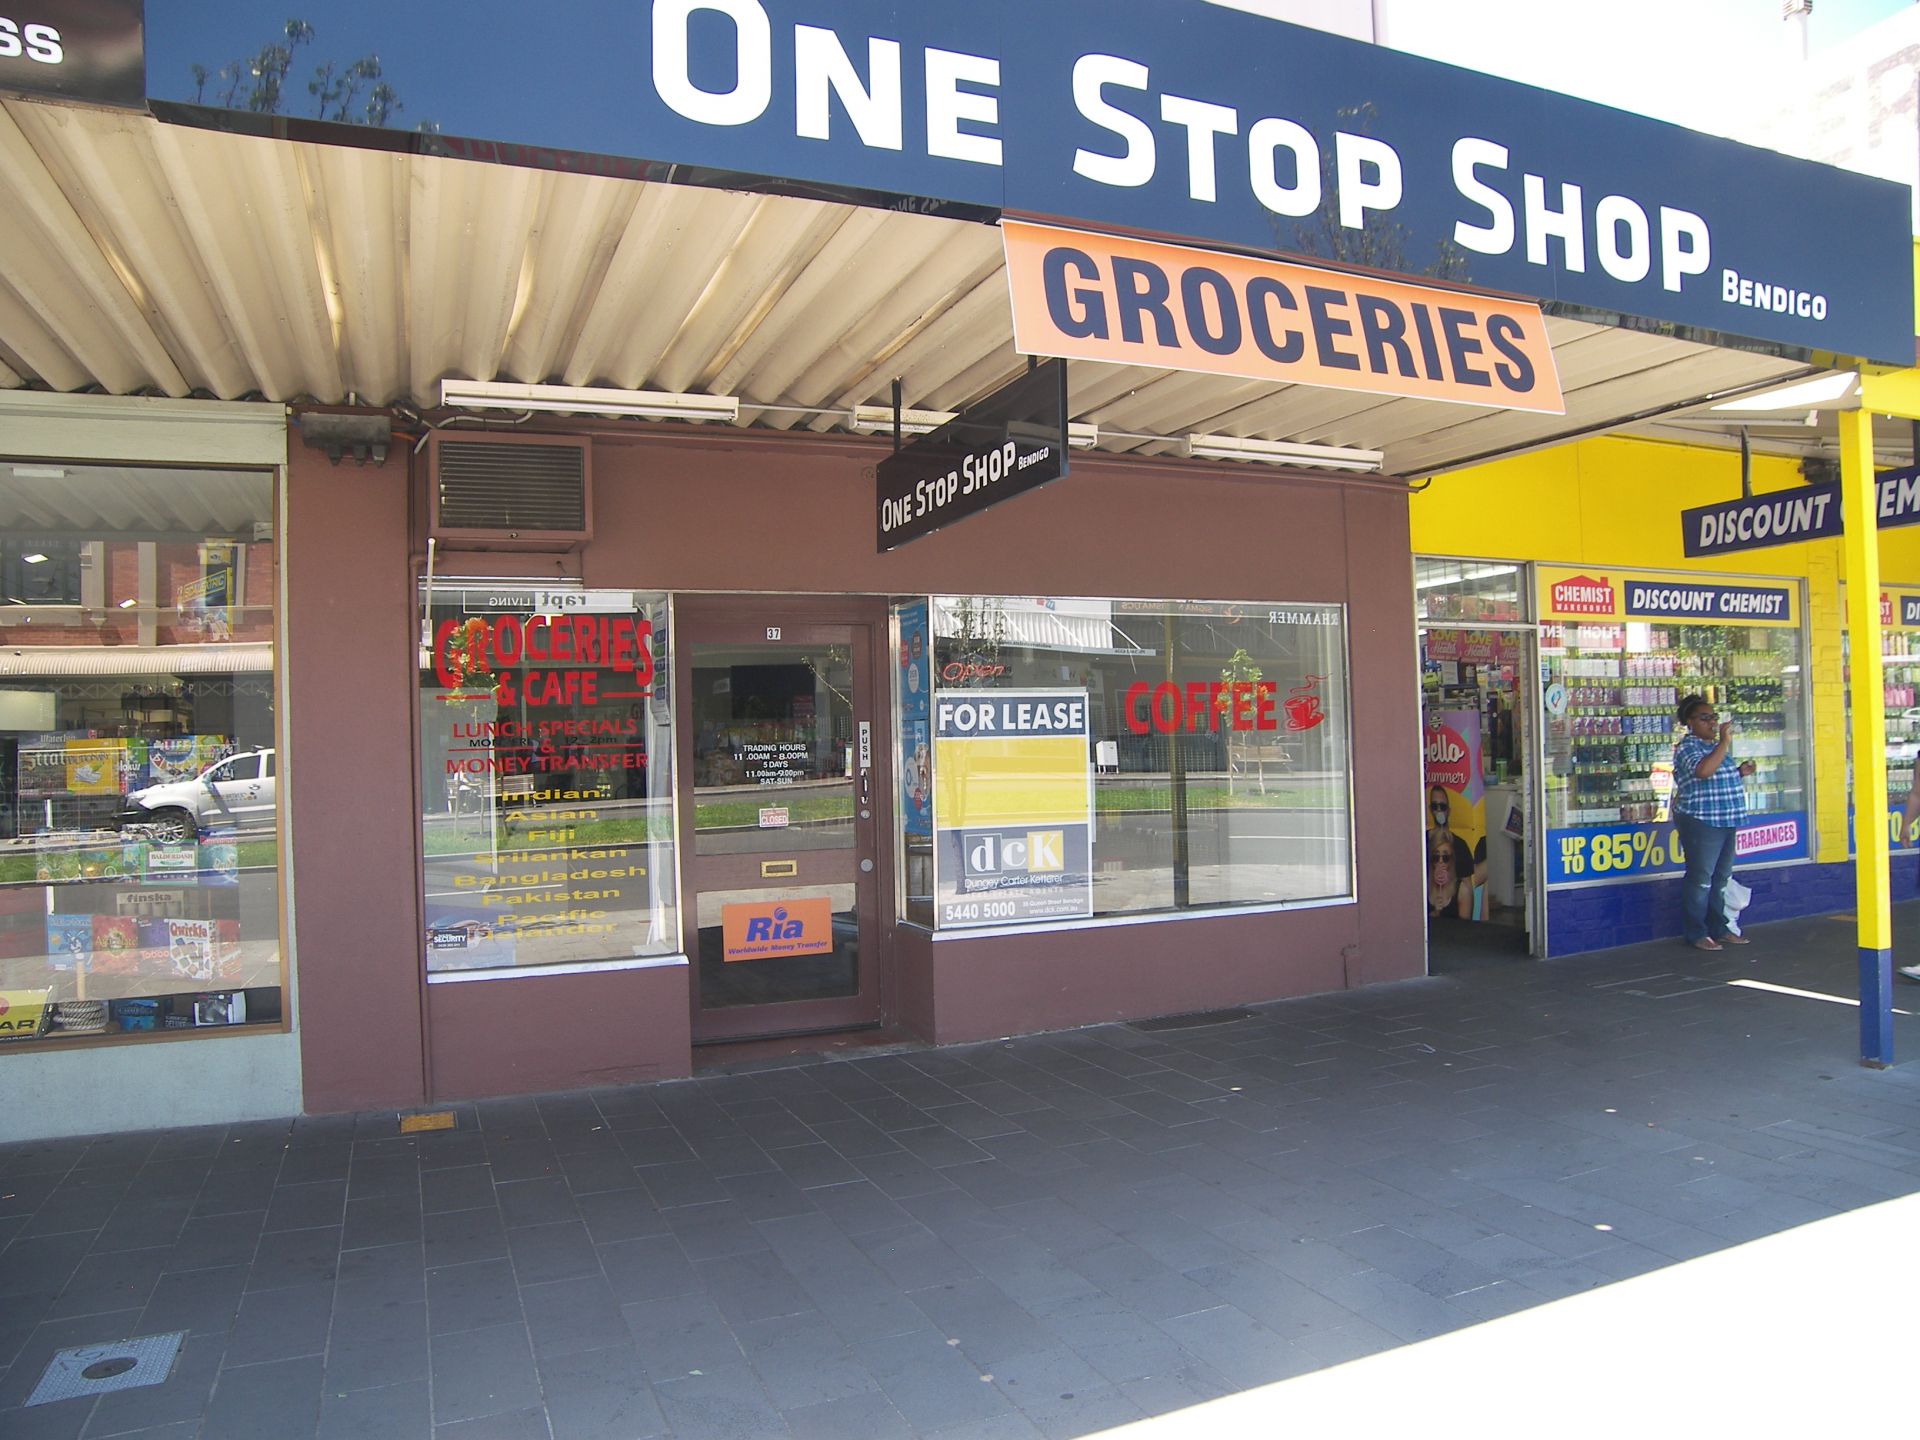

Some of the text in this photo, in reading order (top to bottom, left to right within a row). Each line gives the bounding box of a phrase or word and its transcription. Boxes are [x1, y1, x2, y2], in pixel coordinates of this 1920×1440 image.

[652, 0, 1828, 321] ONE STOP SHOP BENDIGO
[1042, 246, 1536, 393] GROCERIES
[882, 441, 1050, 532] ONE STOP SHOP BENDIGO
[1699, 493, 1832, 548] DISCOUNT
[1555, 585, 1611, 604] CHEMIST
[1632, 588, 1783, 615] DISCOUNT CHEMIST
[1556, 603, 1612, 613] WAREHOUSE
[768, 629, 780, 638] 37
[433, 614, 654, 690] GROCERIES
[943, 662, 1005, 681] Open
[496, 671, 598, 707] & CAFE
[938, 702, 1083, 732] FOR LEASE
[1125, 681, 1277, 735] COFFEE
[453, 718, 637, 739] LUNCH SPECIALS
[540, 738, 555, 754] &
[743, 743, 807, 752] TRADING HOURS
[446, 753, 649, 774] MONEY TRANSFER
[769, 760, 789, 768] DAYS
[501, 788, 600, 802] Indian
[505, 809, 597, 822] Asian
[762, 815, 788, 825] CLOSED
[527, 829, 576, 842] Fiji
[1736, 832, 1795, 850] FRAGRANCES
[1562, 837, 1586, 855] UP
[1590, 831, 1664, 872] 85%
[472, 849, 628, 865] Srilankan
[1562, 854, 1584, 874] TO
[453, 866, 647, 887] Bangladesh
[965, 873, 1063, 890] Dungey Carter Ketterer
[127, 893, 171, 903] finska
[481, 888, 621, 906] Pakistan
[497, 910, 608, 926] Pacific
[946, 901, 1016, 920] 5440 5000
[487, 922, 615, 941] Islander
[746, 907, 804, 942] Ria
[433, 935, 467, 943] SECURITY
[728, 940, 827, 955] Worldwide Money Transfer
